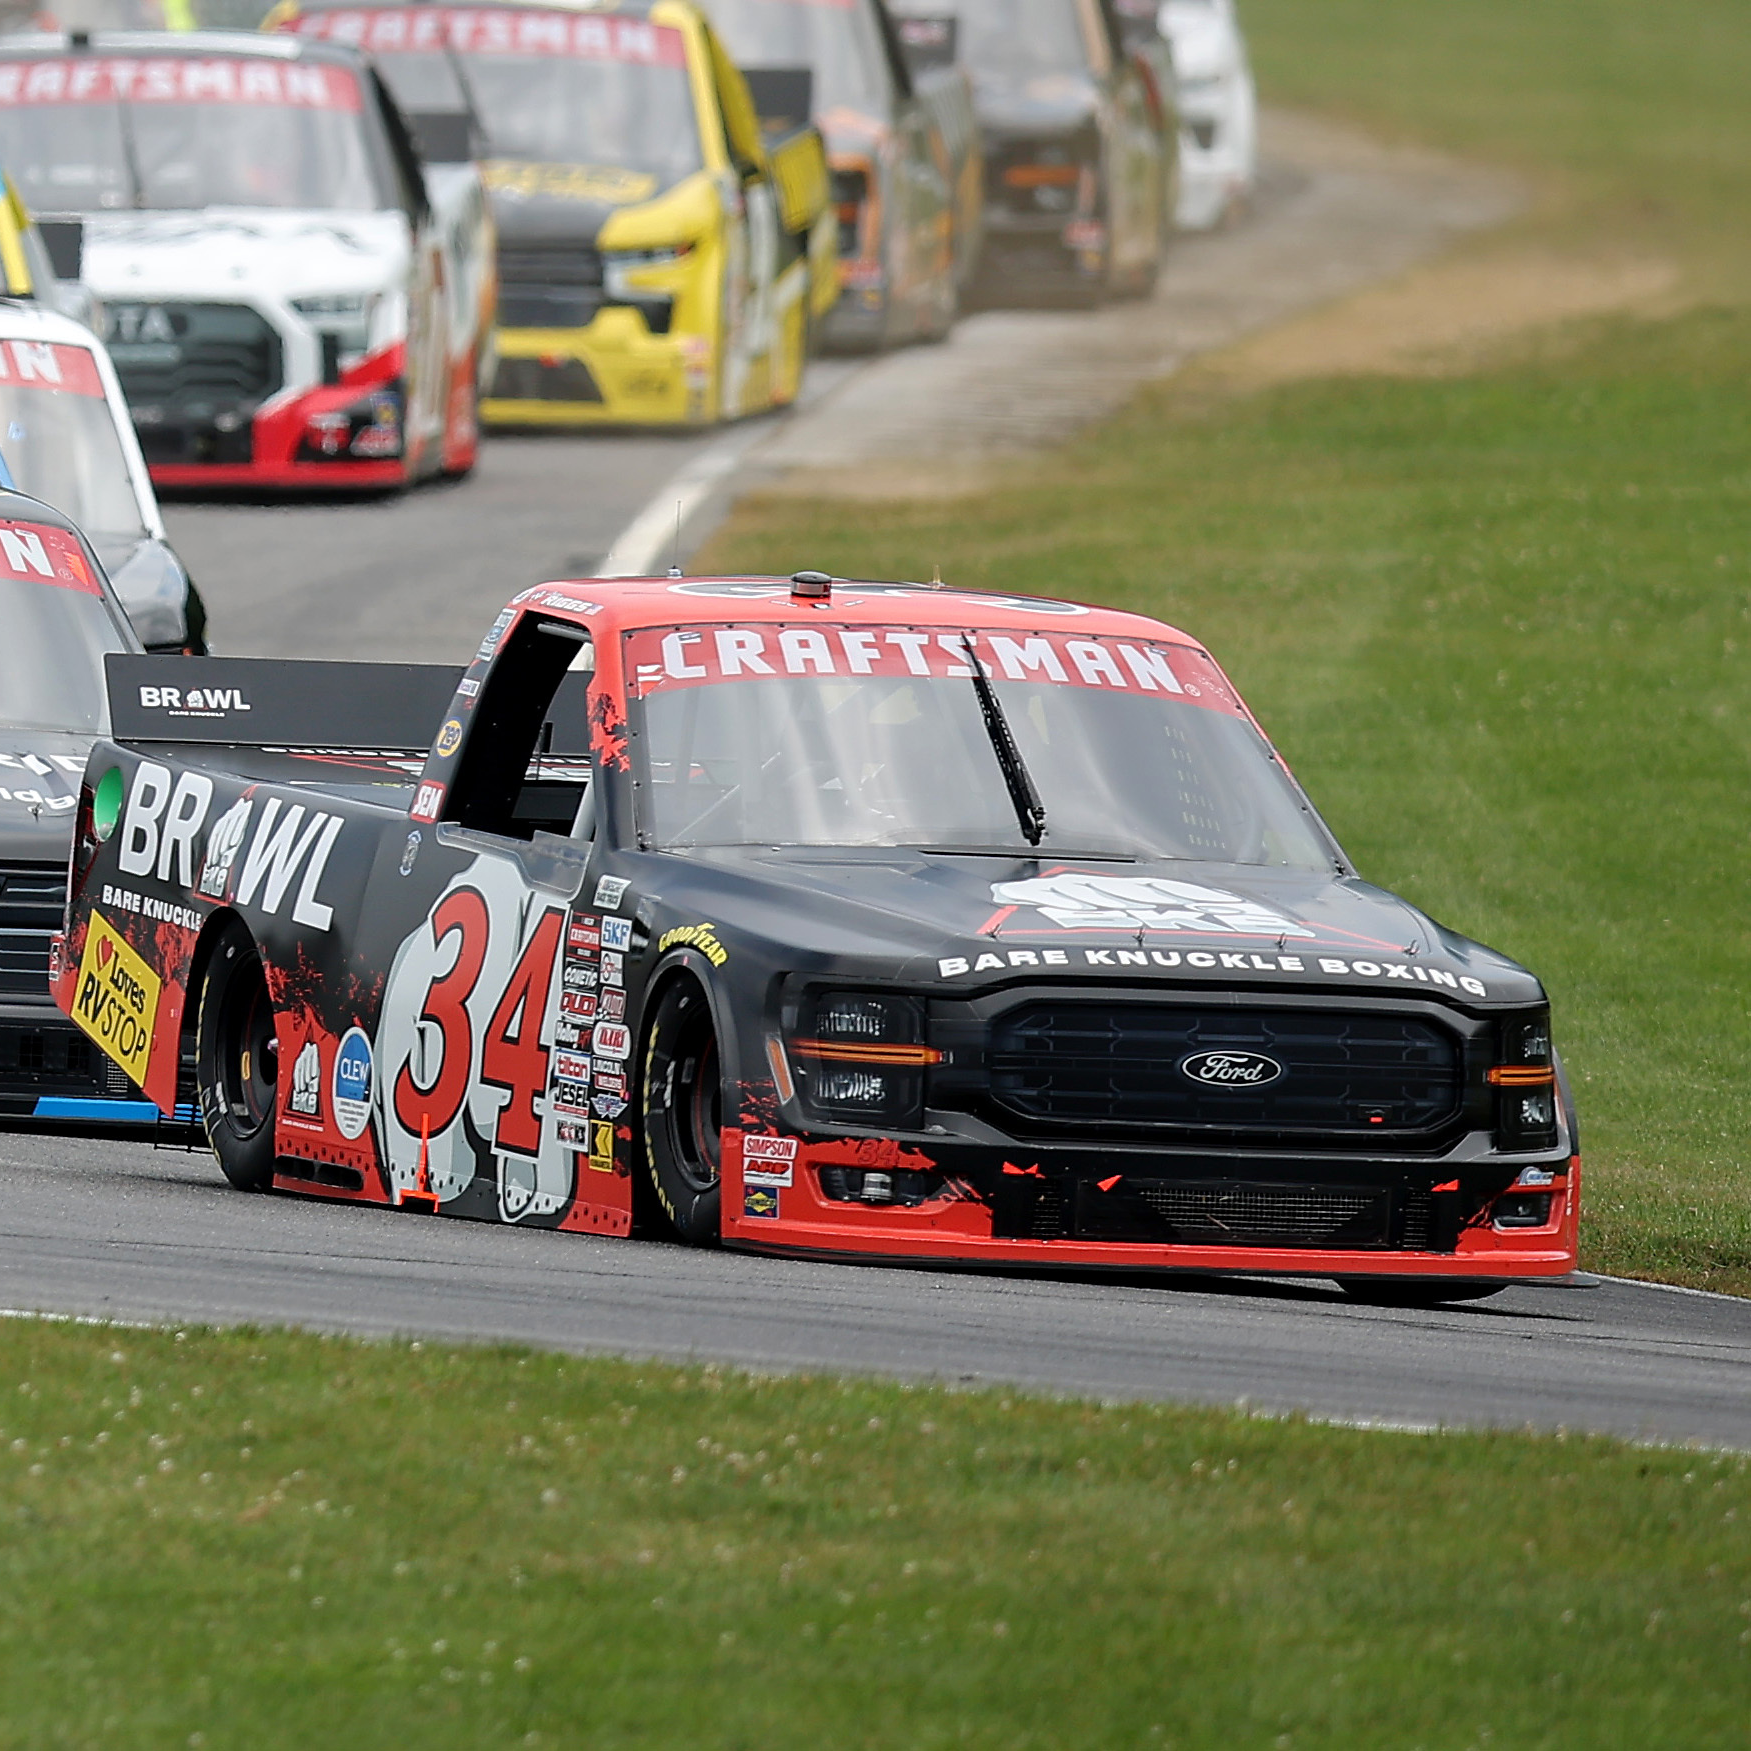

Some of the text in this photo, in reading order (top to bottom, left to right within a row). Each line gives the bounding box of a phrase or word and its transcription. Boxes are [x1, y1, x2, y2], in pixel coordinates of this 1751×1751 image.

[541, 594, 593, 613] RIGGS
[661, 628, 1186, 695] CRAFTSMAN
[139, 685, 252, 711] BRWL
[411, 784, 443, 820] SEM
[117, 760, 345, 933] BRWL
[102, 884, 203, 933] BARE KNUCKLE
[603, 921, 630, 947] SKF
[659, 922, 729, 968] GOODYEAR
[938, 948, 1489, 998] BARE KNUCKLE BOXING
[78, 970, 147, 1065] RV STOP
[393, 883, 567, 1158] 34
[1199, 1053, 1264, 1083] Ford
[746, 1136, 795, 1158] SIMPSON
[747, 1159, 791, 1175] ARP
